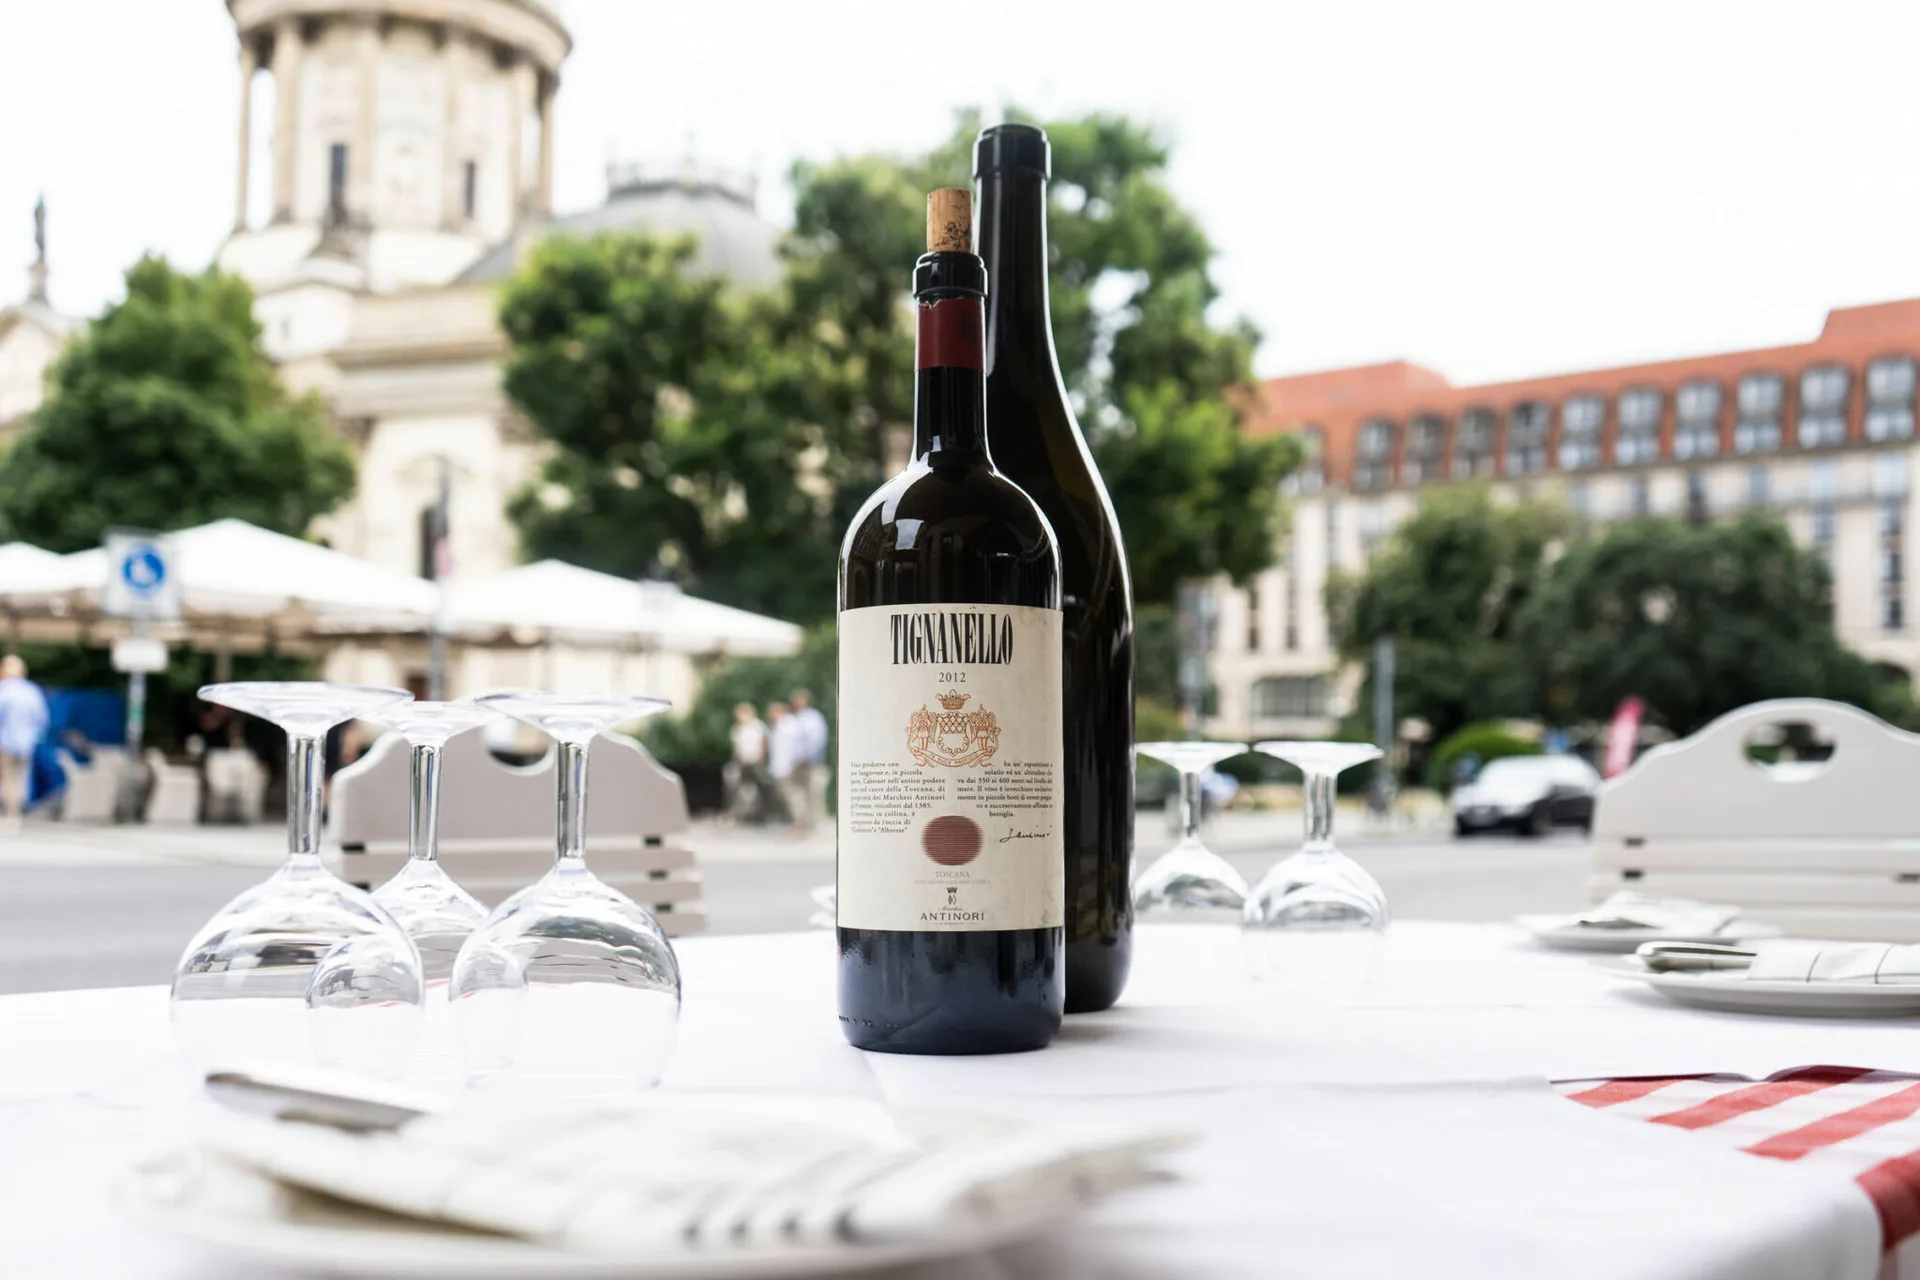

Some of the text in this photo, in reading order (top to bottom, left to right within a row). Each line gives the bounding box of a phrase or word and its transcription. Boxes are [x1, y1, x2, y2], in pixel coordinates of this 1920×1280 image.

[890, 612, 1013, 665] TIGNANELLO
[938, 672, 966, 683] 2012
[920, 912, 984, 921] ANTINORI
